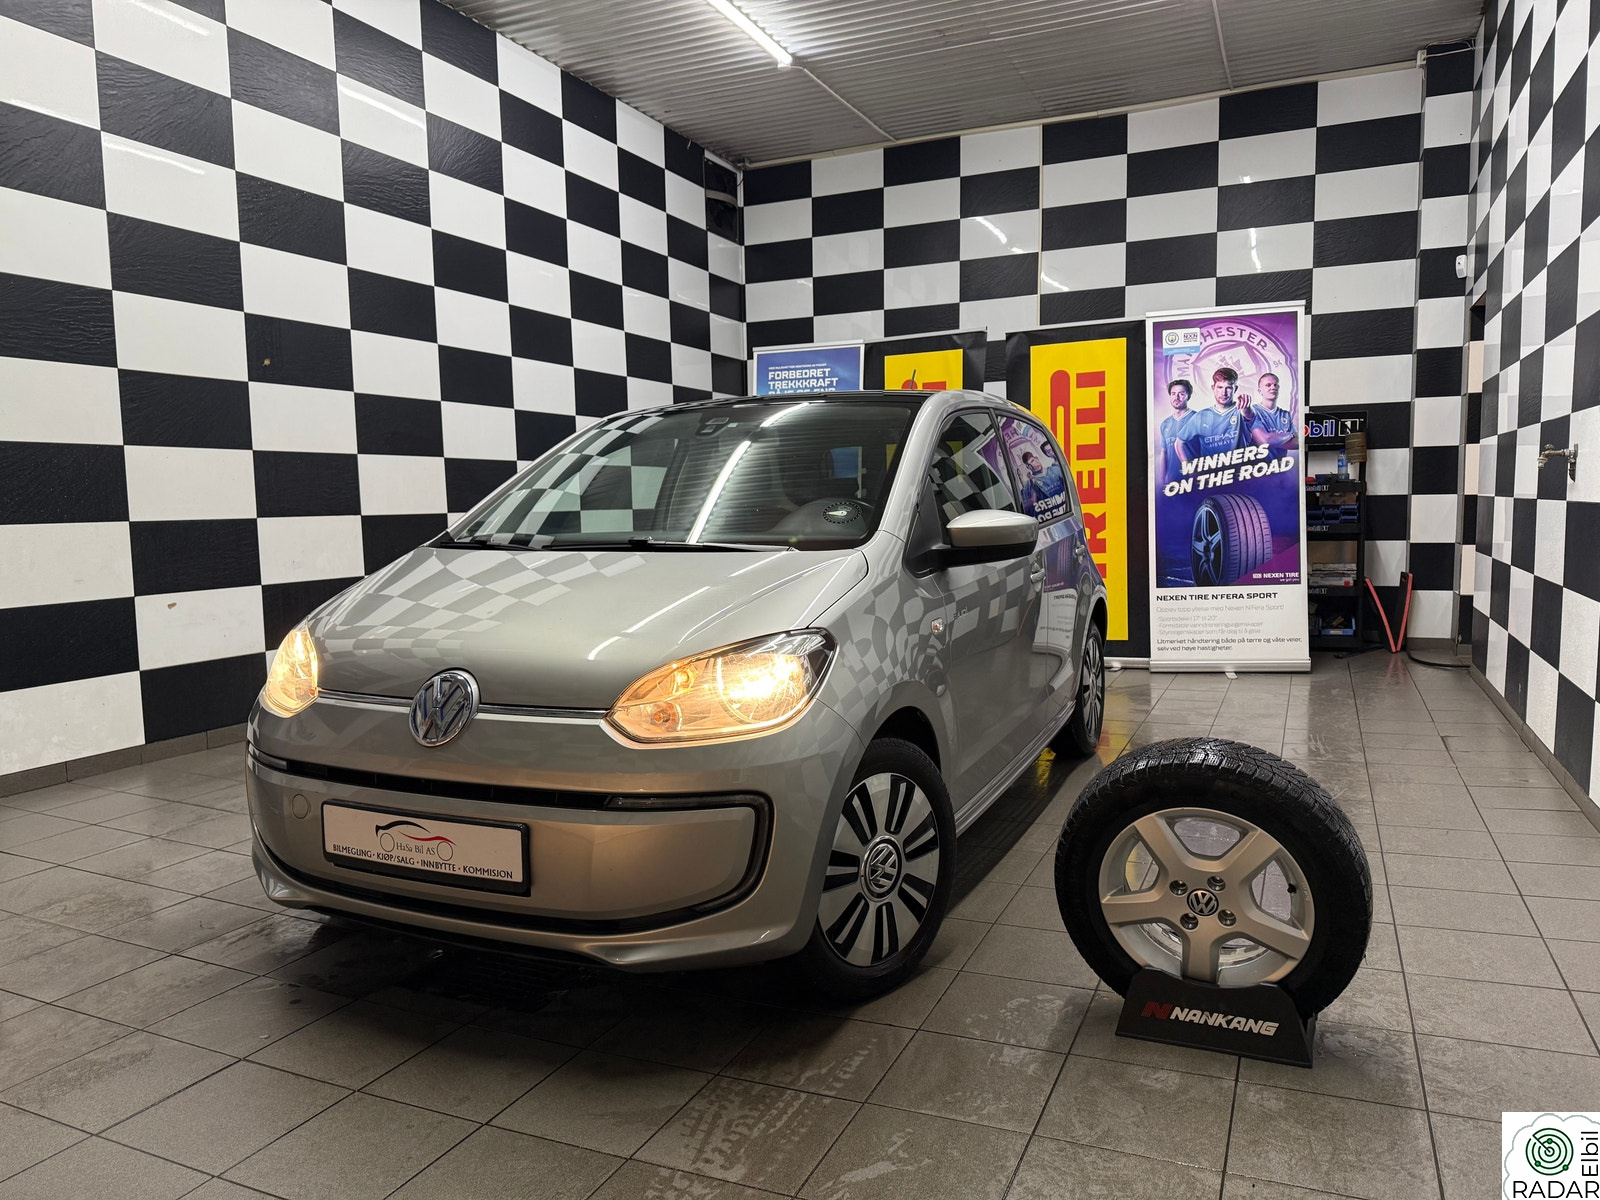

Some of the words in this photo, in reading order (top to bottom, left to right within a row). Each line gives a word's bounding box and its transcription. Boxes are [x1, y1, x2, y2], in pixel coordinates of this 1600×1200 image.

[768, 368, 831, 380] FORBEDRET
[768, 377, 839, 390] TREKKKRAFT
[1304, 420, 1336, 437] bil
[1180, 443, 1270, 475] WINNERS
[1163, 478, 1193, 497] ON
[1197, 469, 1235, 490] THE
[1239, 456, 1294, 481] ROAD
[396, 842, 413, 852] HaSa
[414, 845, 424, 854] Bil
[426, 846, 436, 856] AS
[376, 851, 415, 866] KJØP/SALG
[420, 860, 456, 872] INNBYTTE
[462, 865, 513, 879] KOMMISJON
[1170, 1006, 1280, 1037] NANKANG
